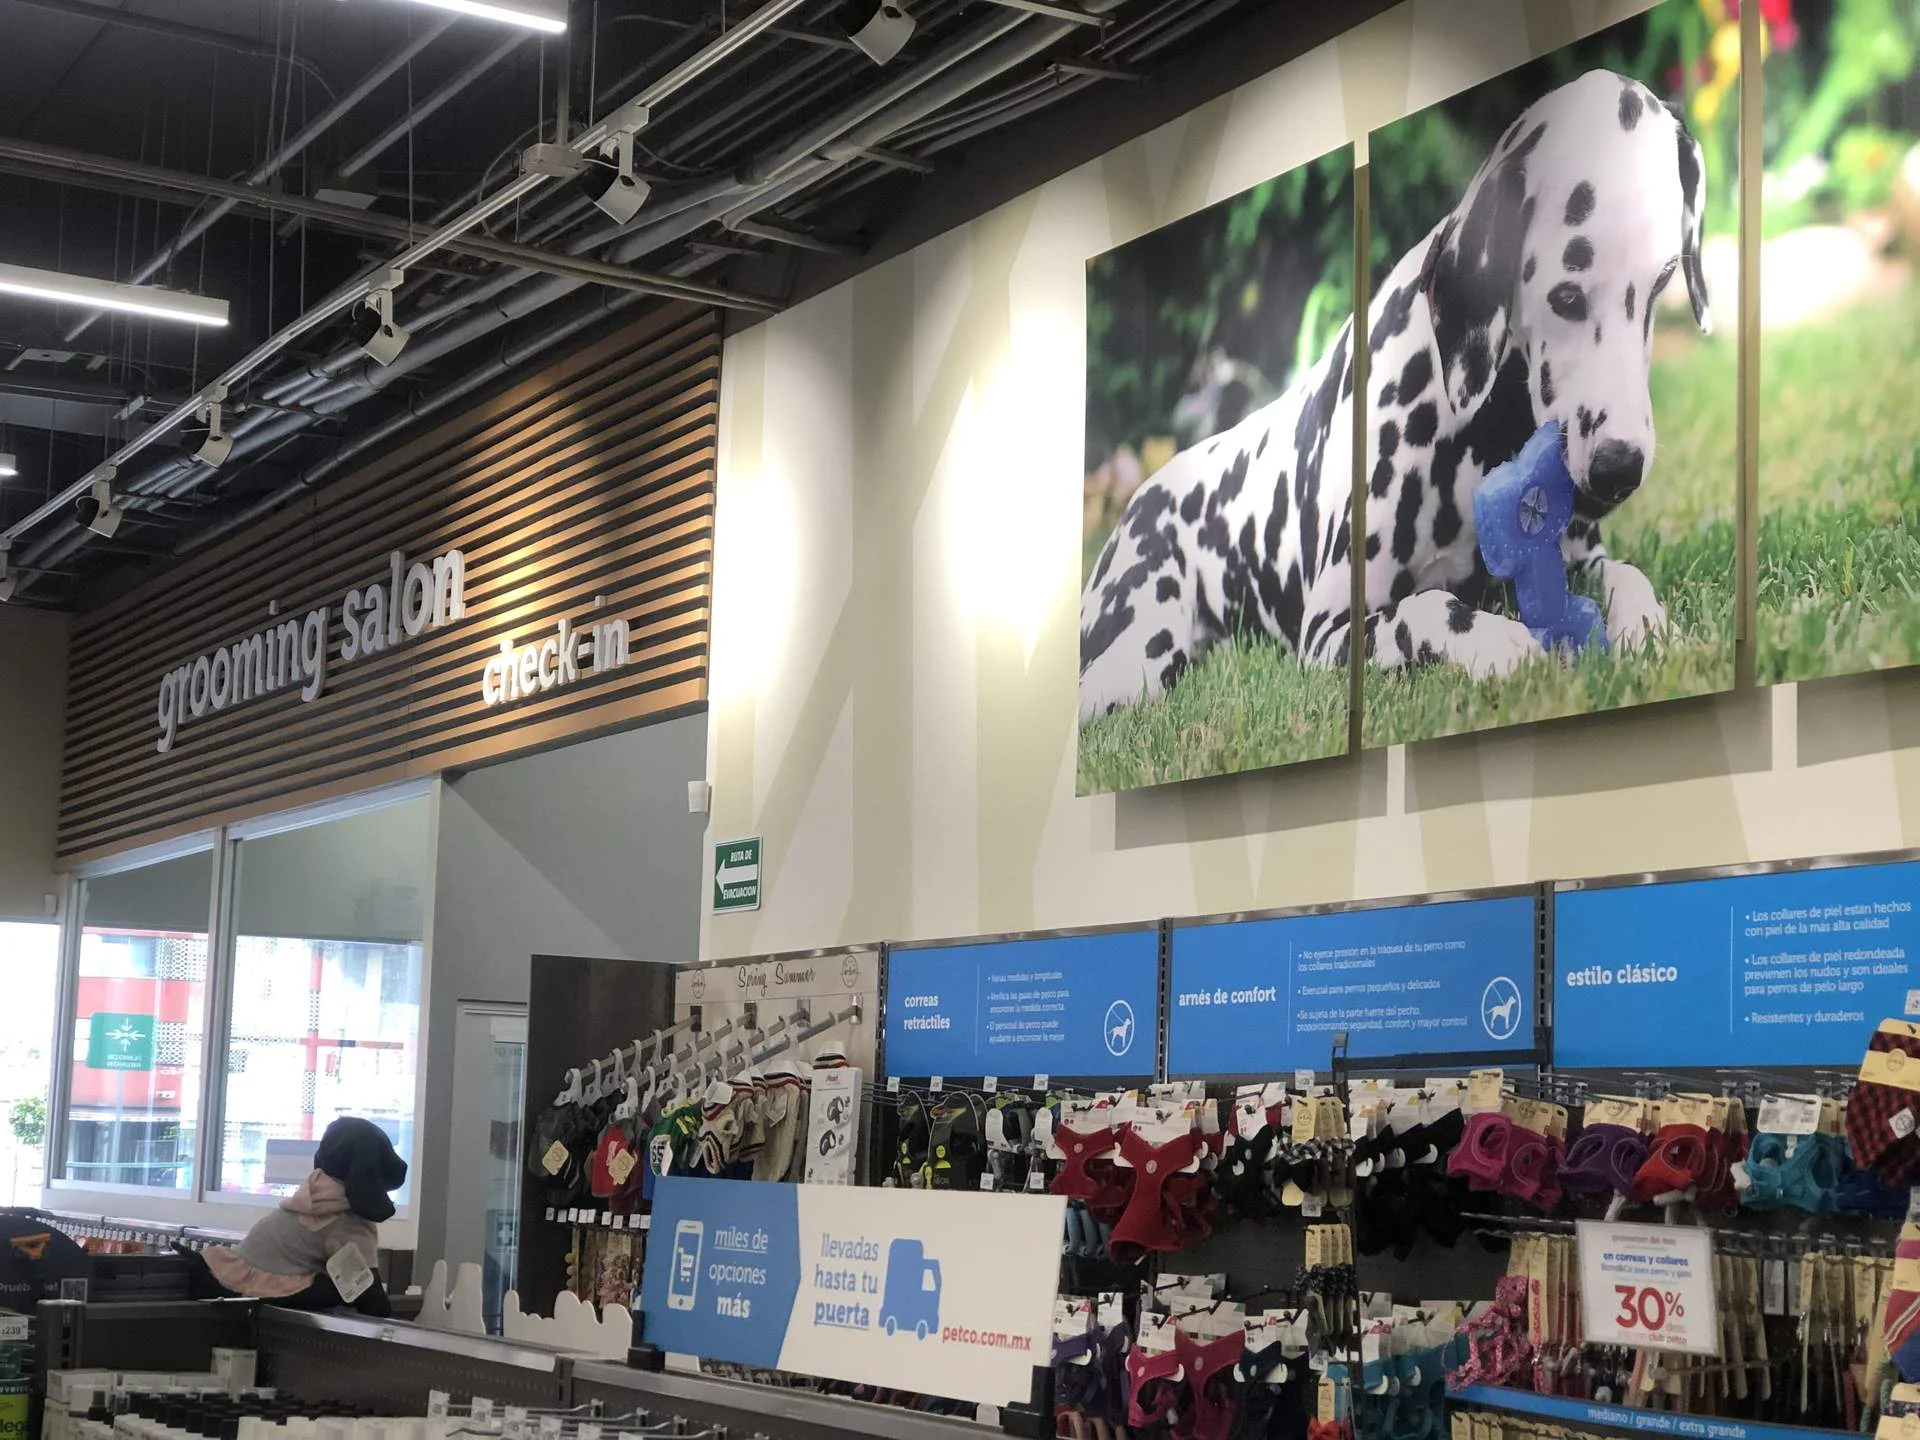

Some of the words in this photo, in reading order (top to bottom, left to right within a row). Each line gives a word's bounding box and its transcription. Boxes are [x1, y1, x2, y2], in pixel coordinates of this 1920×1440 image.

[156, 600, 329, 752] grooming
[340, 549, 466, 662] salon
[482, 595, 631, 706] check-in
[745, 849, 752, 860] DE
[1752, 911, 1768, 922] Los
[1770, 908, 1807, 920] collares
[1809, 906, 1821, 918] de
[1824, 905, 1842, 919] piel
[1873, 901, 1911, 914] hechos
[1744, 926, 1763, 937] con
[1765, 924, 1782, 938] piel
[1784, 922, 1797, 935] de
[1799, 922, 1808, 934] la
[1832, 919, 1851, 931] alta
[1853, 917, 1889, 931] calidad
[1423, 942, 1443, 952] perro
[1752, 954, 1768, 965] Los
[1770, 952, 1806, 964] collares
[1808, 951, 1821, 962] de
[1823, 949, 1842, 964] piel
[1844, 946, 1905, 961] redondeada
[737, 965, 768, 998] Spring
[775, 963, 816, 986] Summer
[1567, 965, 1613, 986] estilo
[1617, 962, 1678, 984] clásico
[1744, 968, 1792, 982] previenen
[1794, 966, 1808, 978] los
[1810, 965, 1841, 977] nudos
[1842, 967, 1850, 979] y
[1851, 965, 1871, 975] son
[1872, 962, 1908, 975] ideales
[1179, 989, 1211, 1007] arnés
[1213, 988, 1228, 1004] de
[1231, 986, 1276, 1003] confort
[1744, 985, 1765, 996] para
[1767, 983, 1798, 996] perros
[1799, 981, 1812, 992] de
[1814, 980, 1836, 994] pelo
[1838, 979, 1864, 994] largo
[904, 995, 939, 1008] correas
[903, 1014, 951, 1031] retráctiles
[1751, 1011, 1803, 1024] Resistentes
[1814, 1010, 1864, 1023] duraderos
[714, 1225, 748, 1251] miles
[752, 1227, 769, 1251] de
[820, 1232, 879, 1262] llevadas
[1603, 1252, 1613, 1260] en
[1615, 1253, 1646, 1263] correas
[1648, 1255, 1653, 1264] y
[1655, 1255, 1688, 1266] collares
[708, 1262, 767, 1287] opciones
[814, 1264, 857, 1292] hasta
[861, 1270, 879, 1295] tu
[716, 1292, 751, 1319] más
[814, 1300, 870, 1327] puerta
[1614, 1284, 1685, 1331] 30%
[941, 1323, 1032, 1352] petco.com.mx
[1587, 1408, 1628, 1424] mediano
[1636, 1415, 1671, 1428] grande
[1679, 1420, 1705, 1434] extra
[1707, 1424, 1746, 1438] grande
